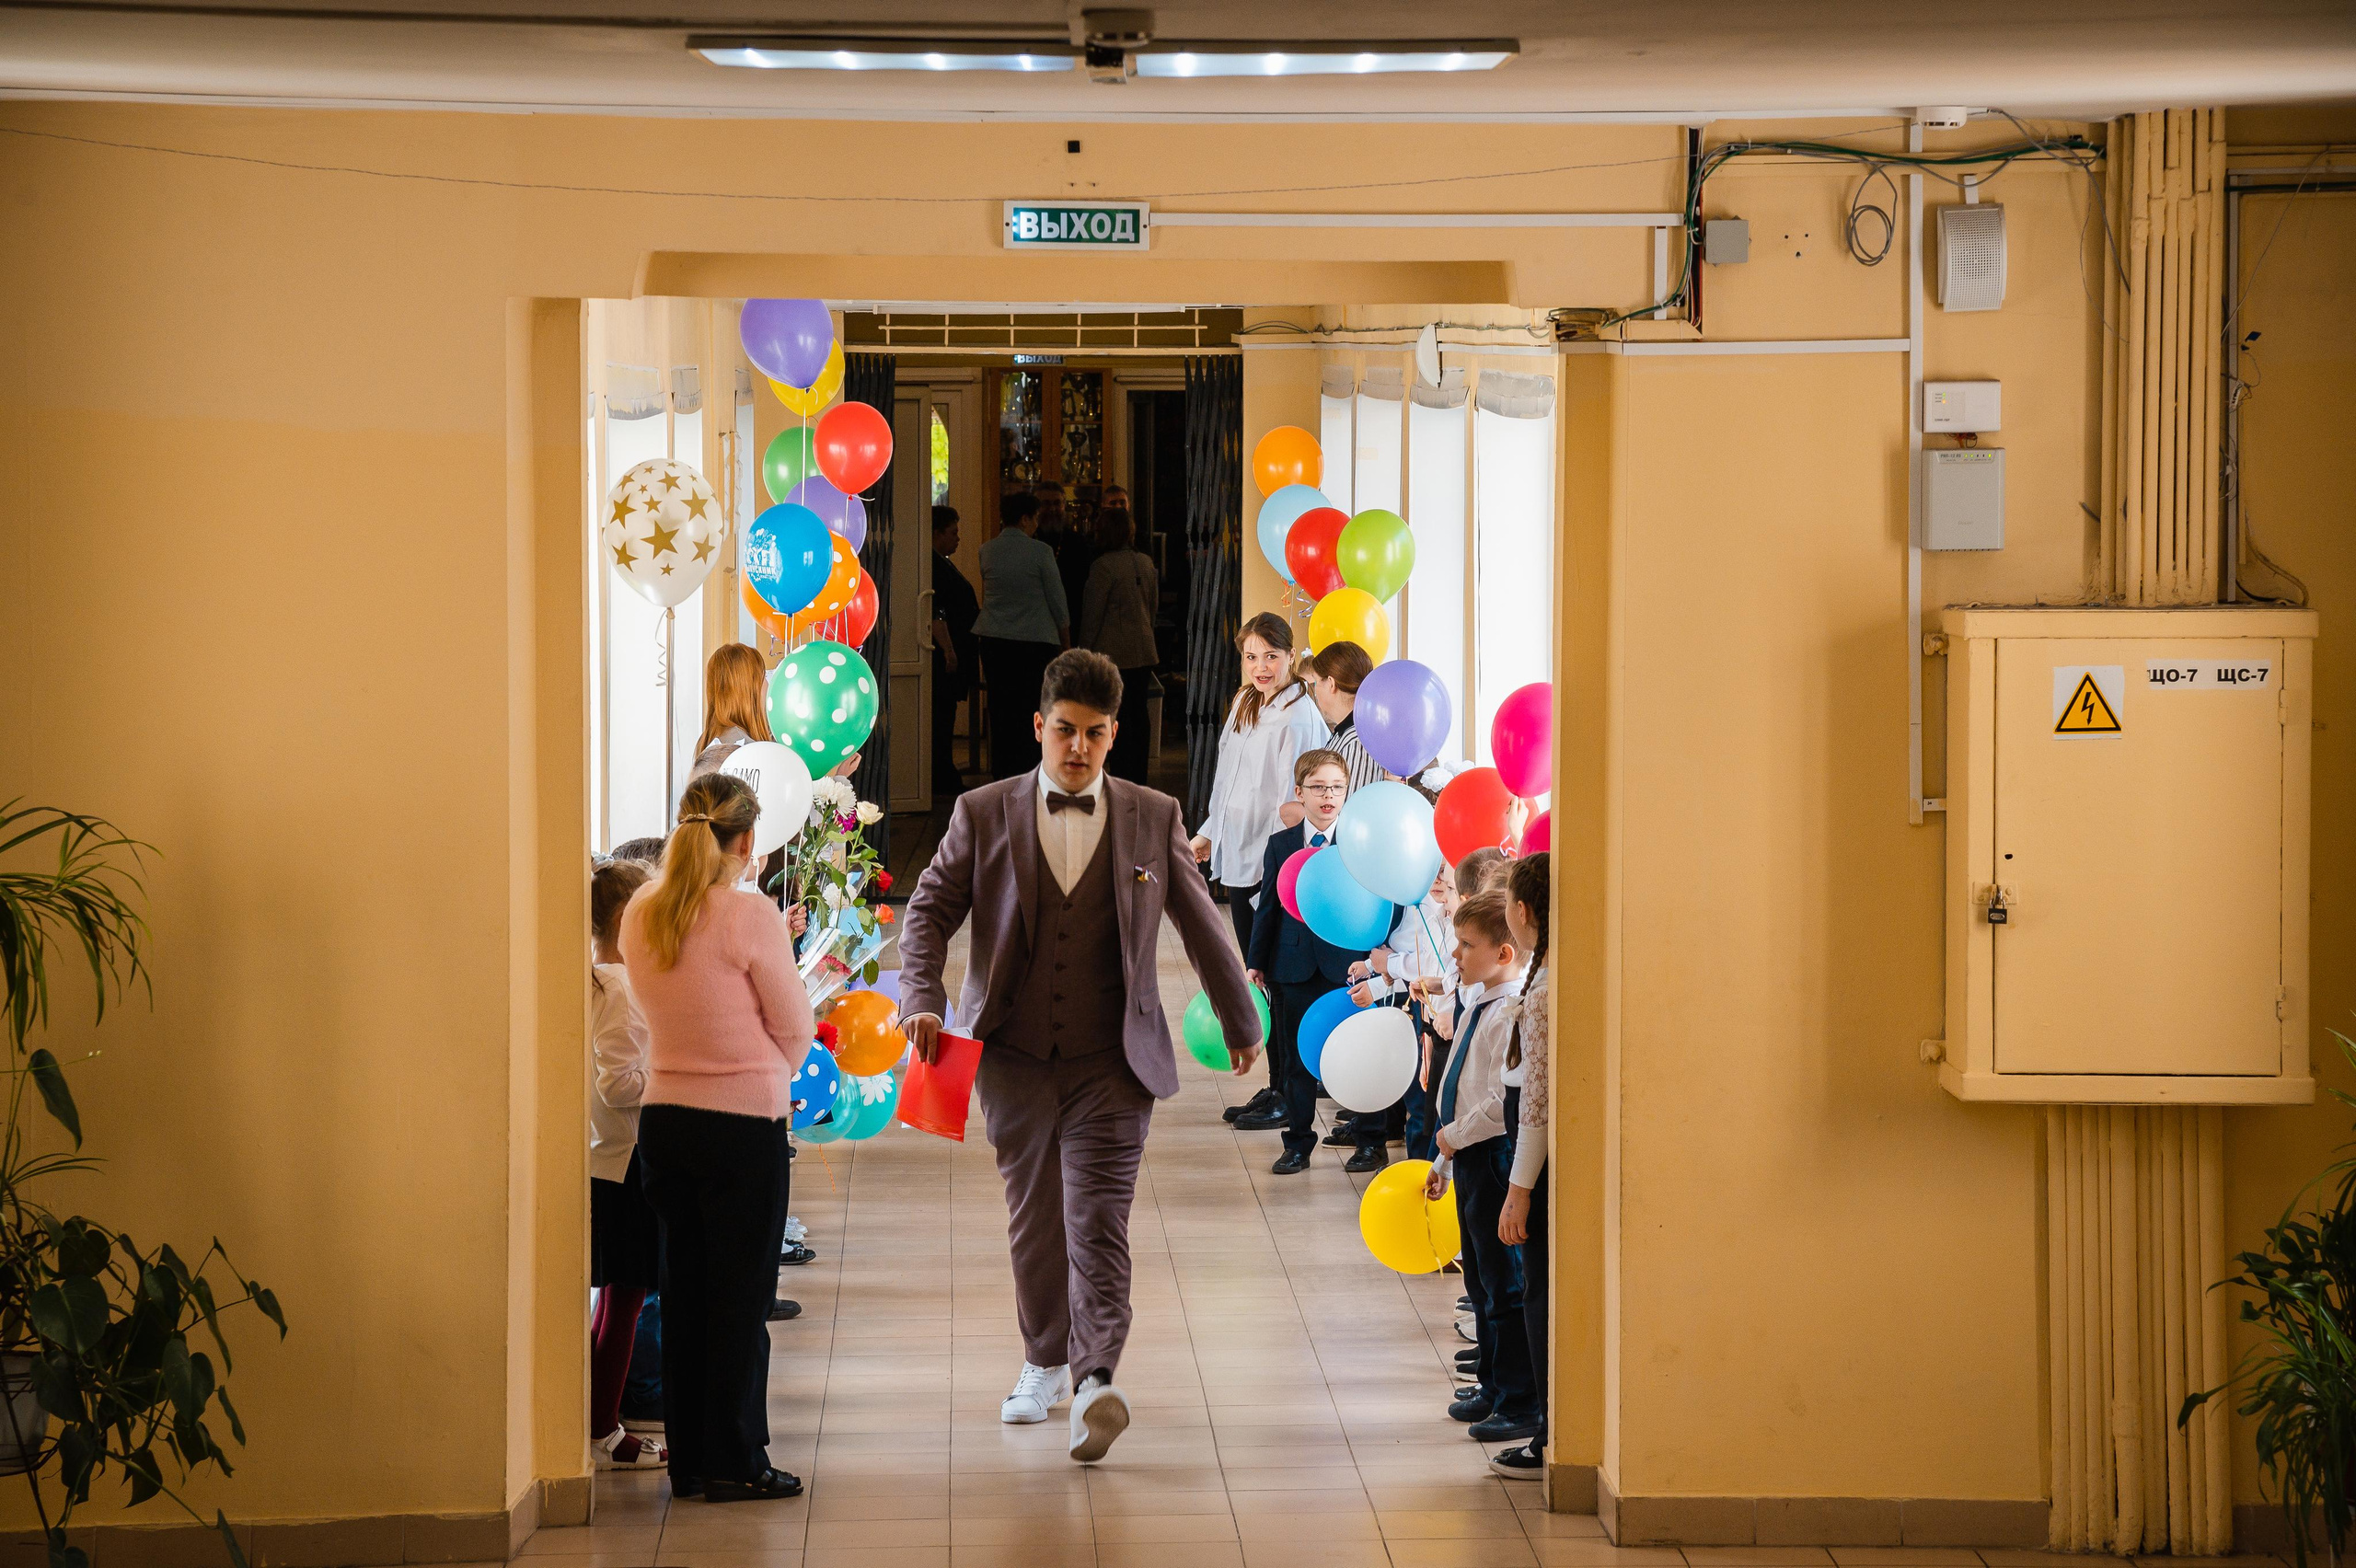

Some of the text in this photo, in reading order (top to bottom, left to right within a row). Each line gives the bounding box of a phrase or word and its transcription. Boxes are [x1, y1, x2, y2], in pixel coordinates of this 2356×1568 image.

[1019, 212, 1135, 242] ВЫХОД
[2147, 668, 2269, 685] ЩО-7 ЩС-7
